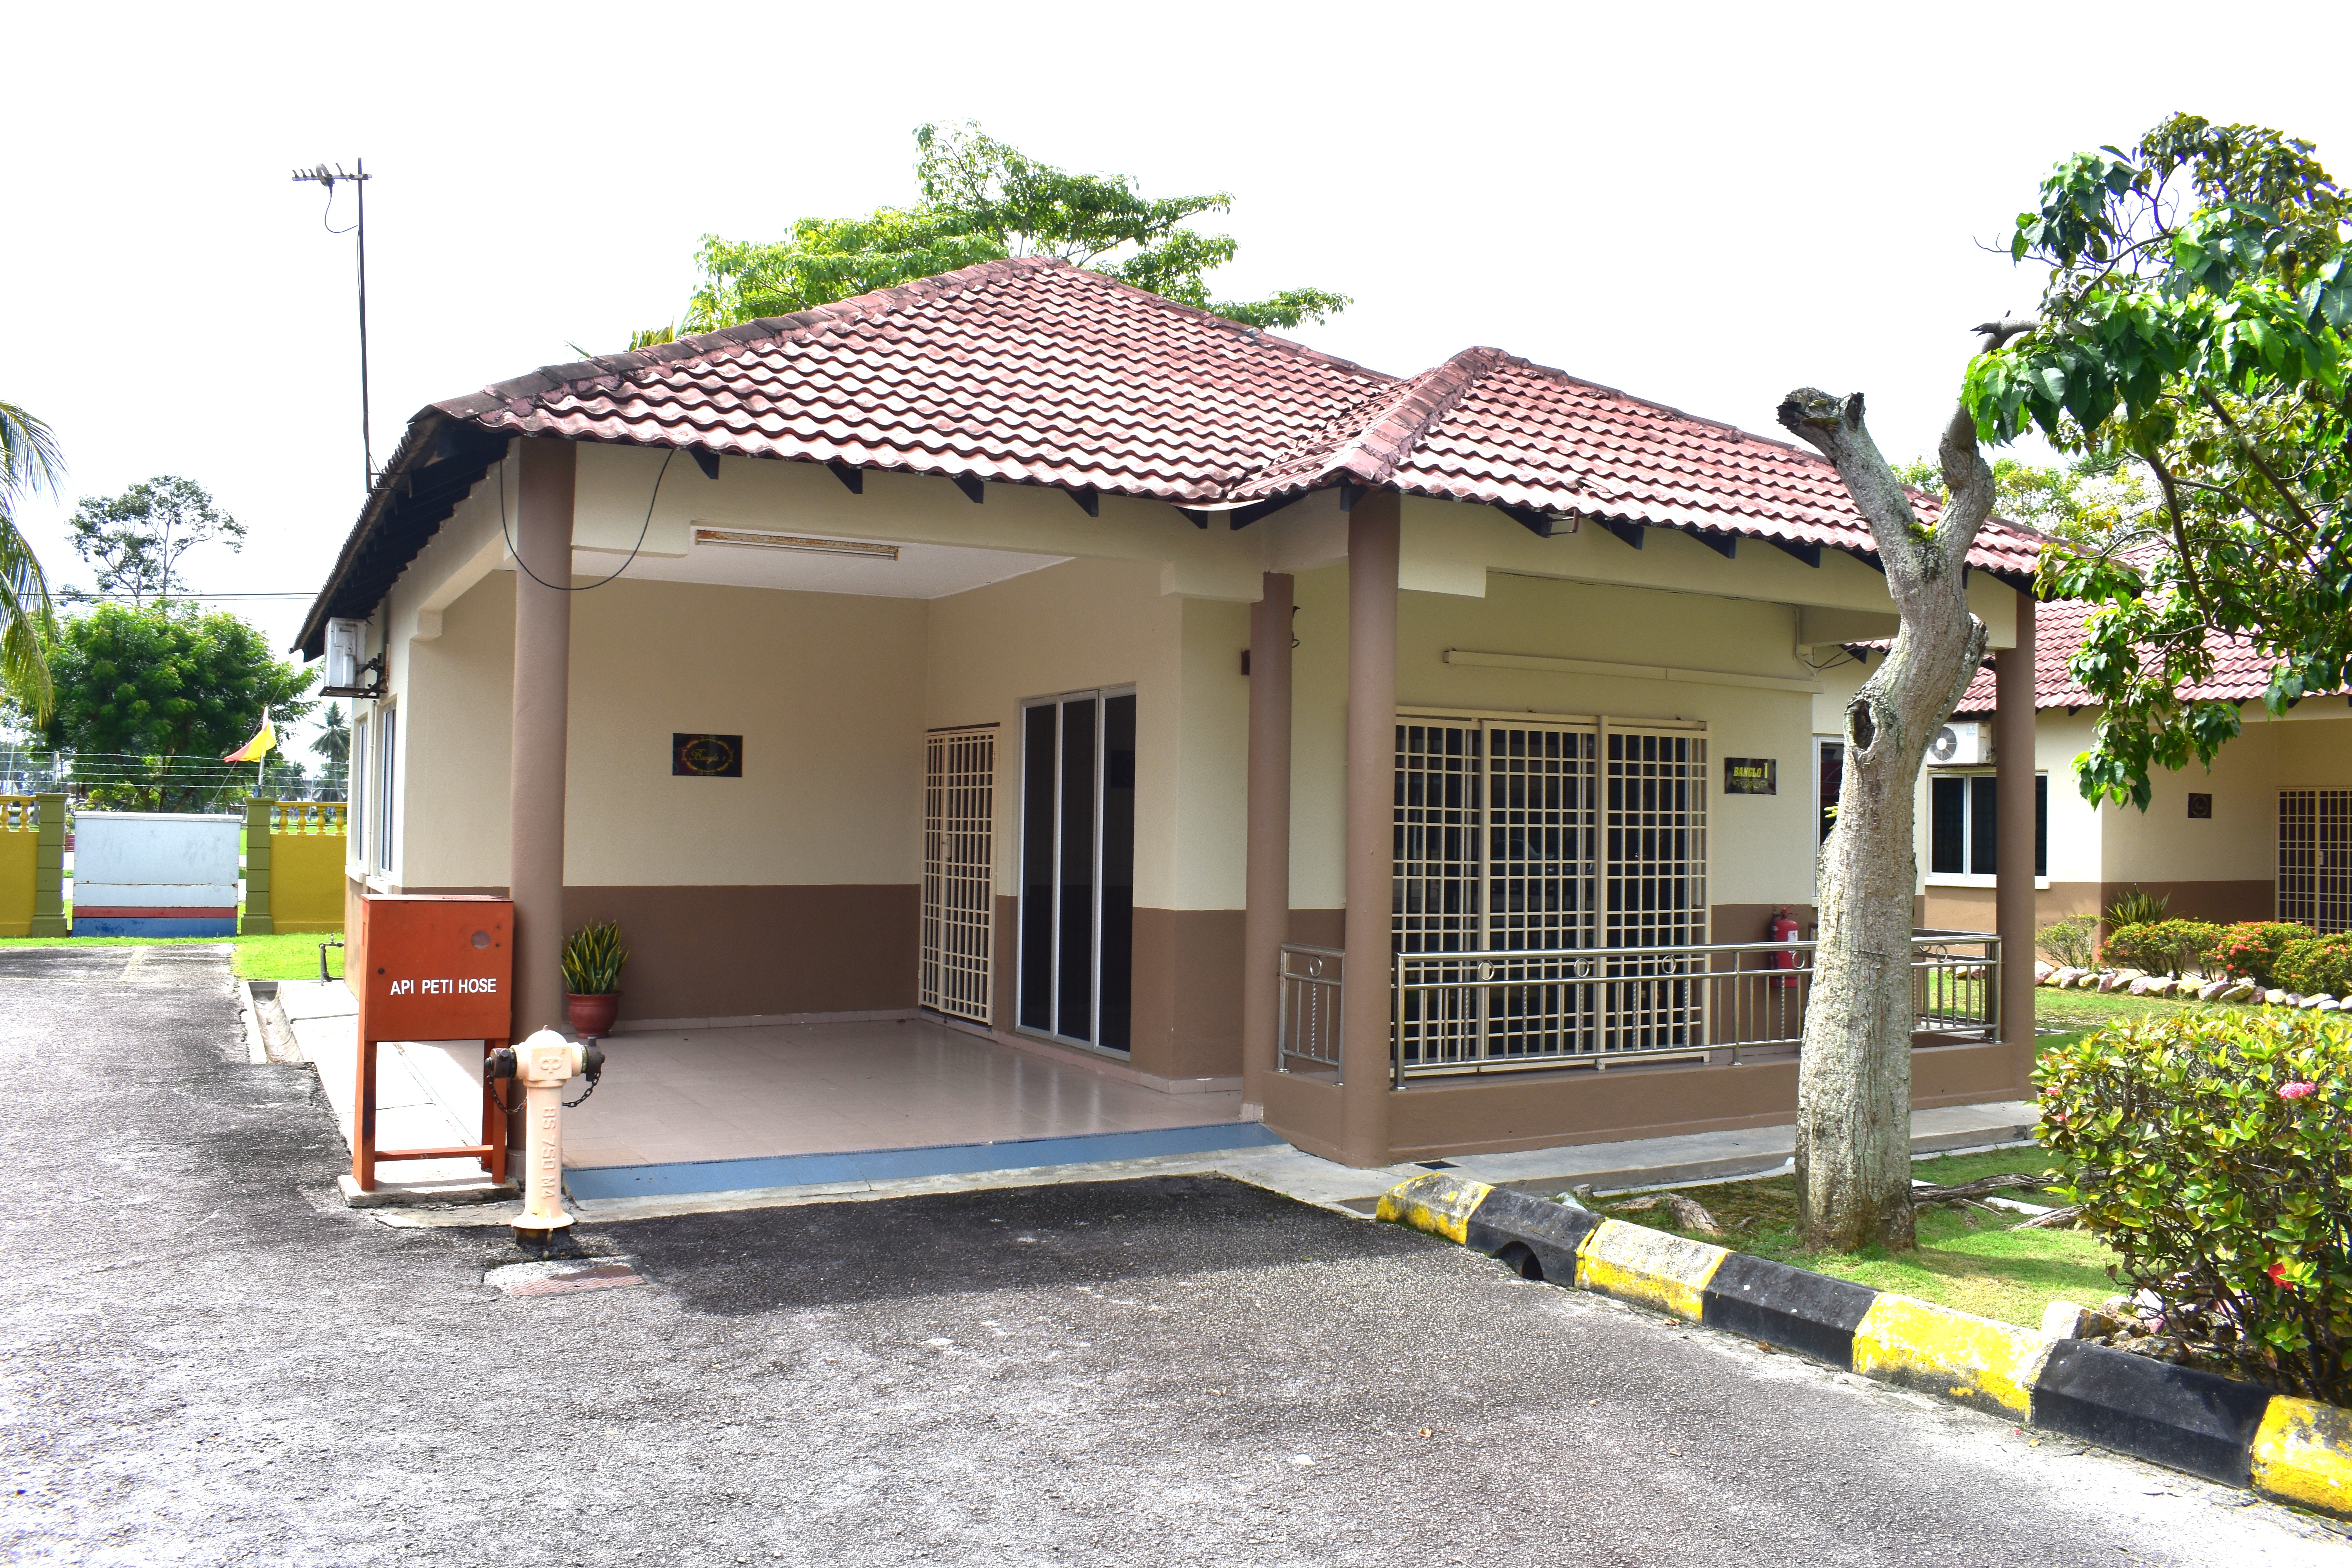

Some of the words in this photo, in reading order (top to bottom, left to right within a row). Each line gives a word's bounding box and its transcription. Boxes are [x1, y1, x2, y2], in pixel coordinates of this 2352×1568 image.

[1733, 766, 1762, 777] BANGLO
[1764, 762, 1768, 779] 1
[390, 980, 414, 995] API
[422, 979, 453, 994] PETI
[458, 978, 497, 993] HOSE
[543, 1107, 556, 1129] BS
[542, 1135, 555, 1169] 750
[541, 1176, 555, 1199] M4
